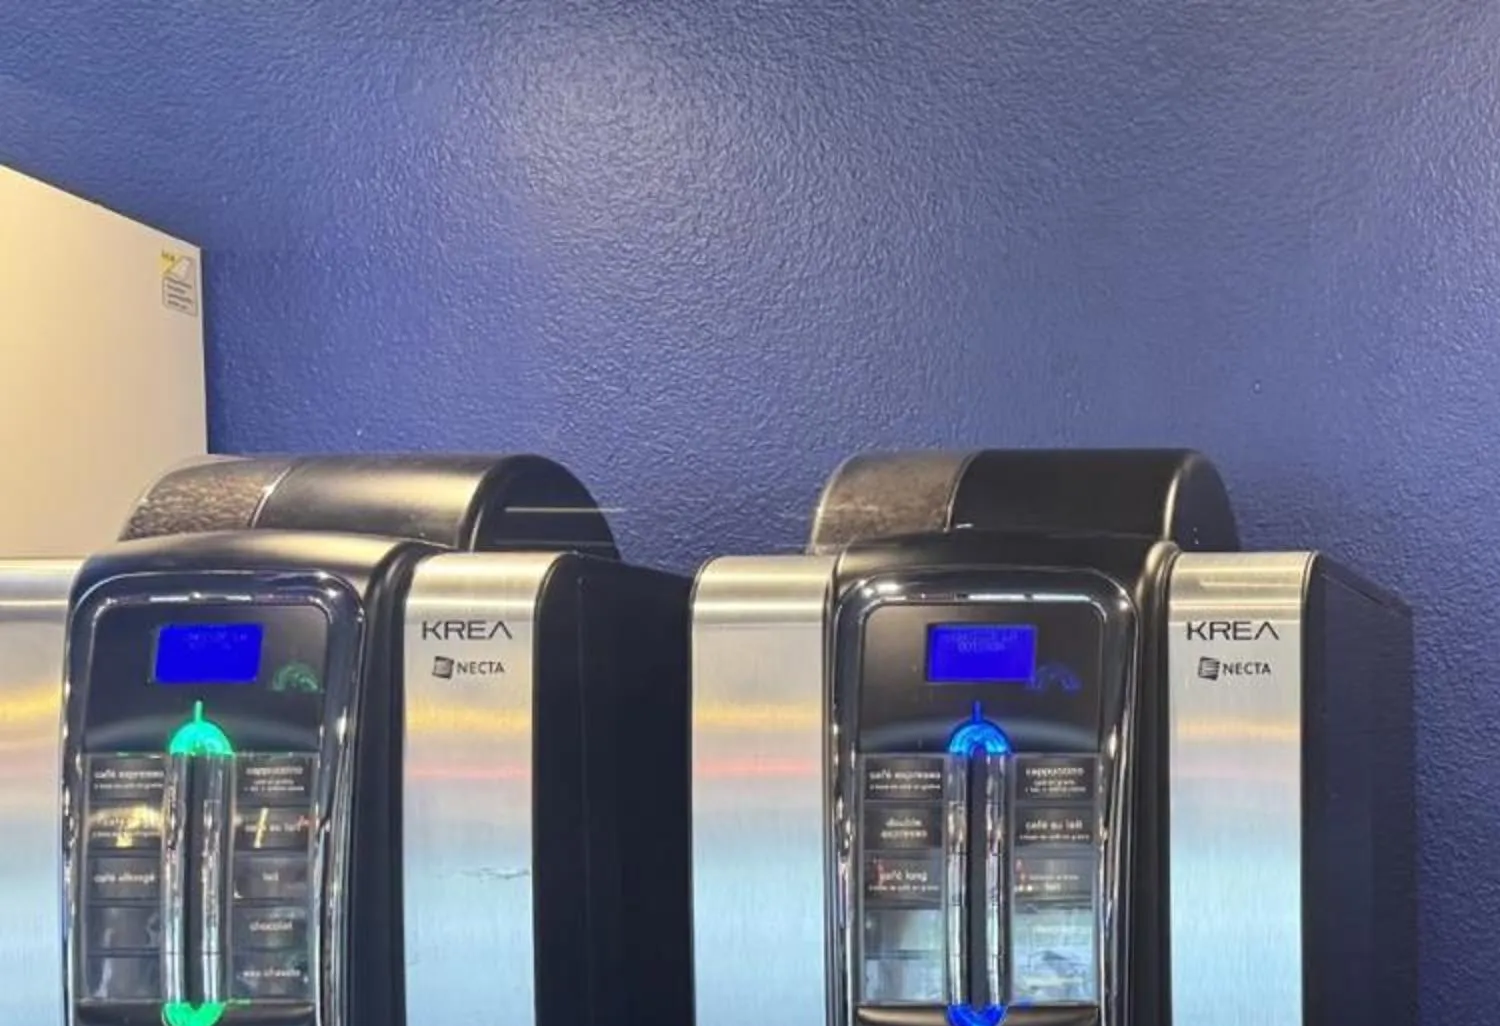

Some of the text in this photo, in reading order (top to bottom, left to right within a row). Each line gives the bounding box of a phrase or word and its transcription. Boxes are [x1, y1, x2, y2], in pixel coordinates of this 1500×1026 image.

[422, 620, 513, 641] KREA
[1187, 620, 1280, 641] KREA
[456, 661, 505, 675] NECTA
[1222, 661, 1272, 676] NECTA
